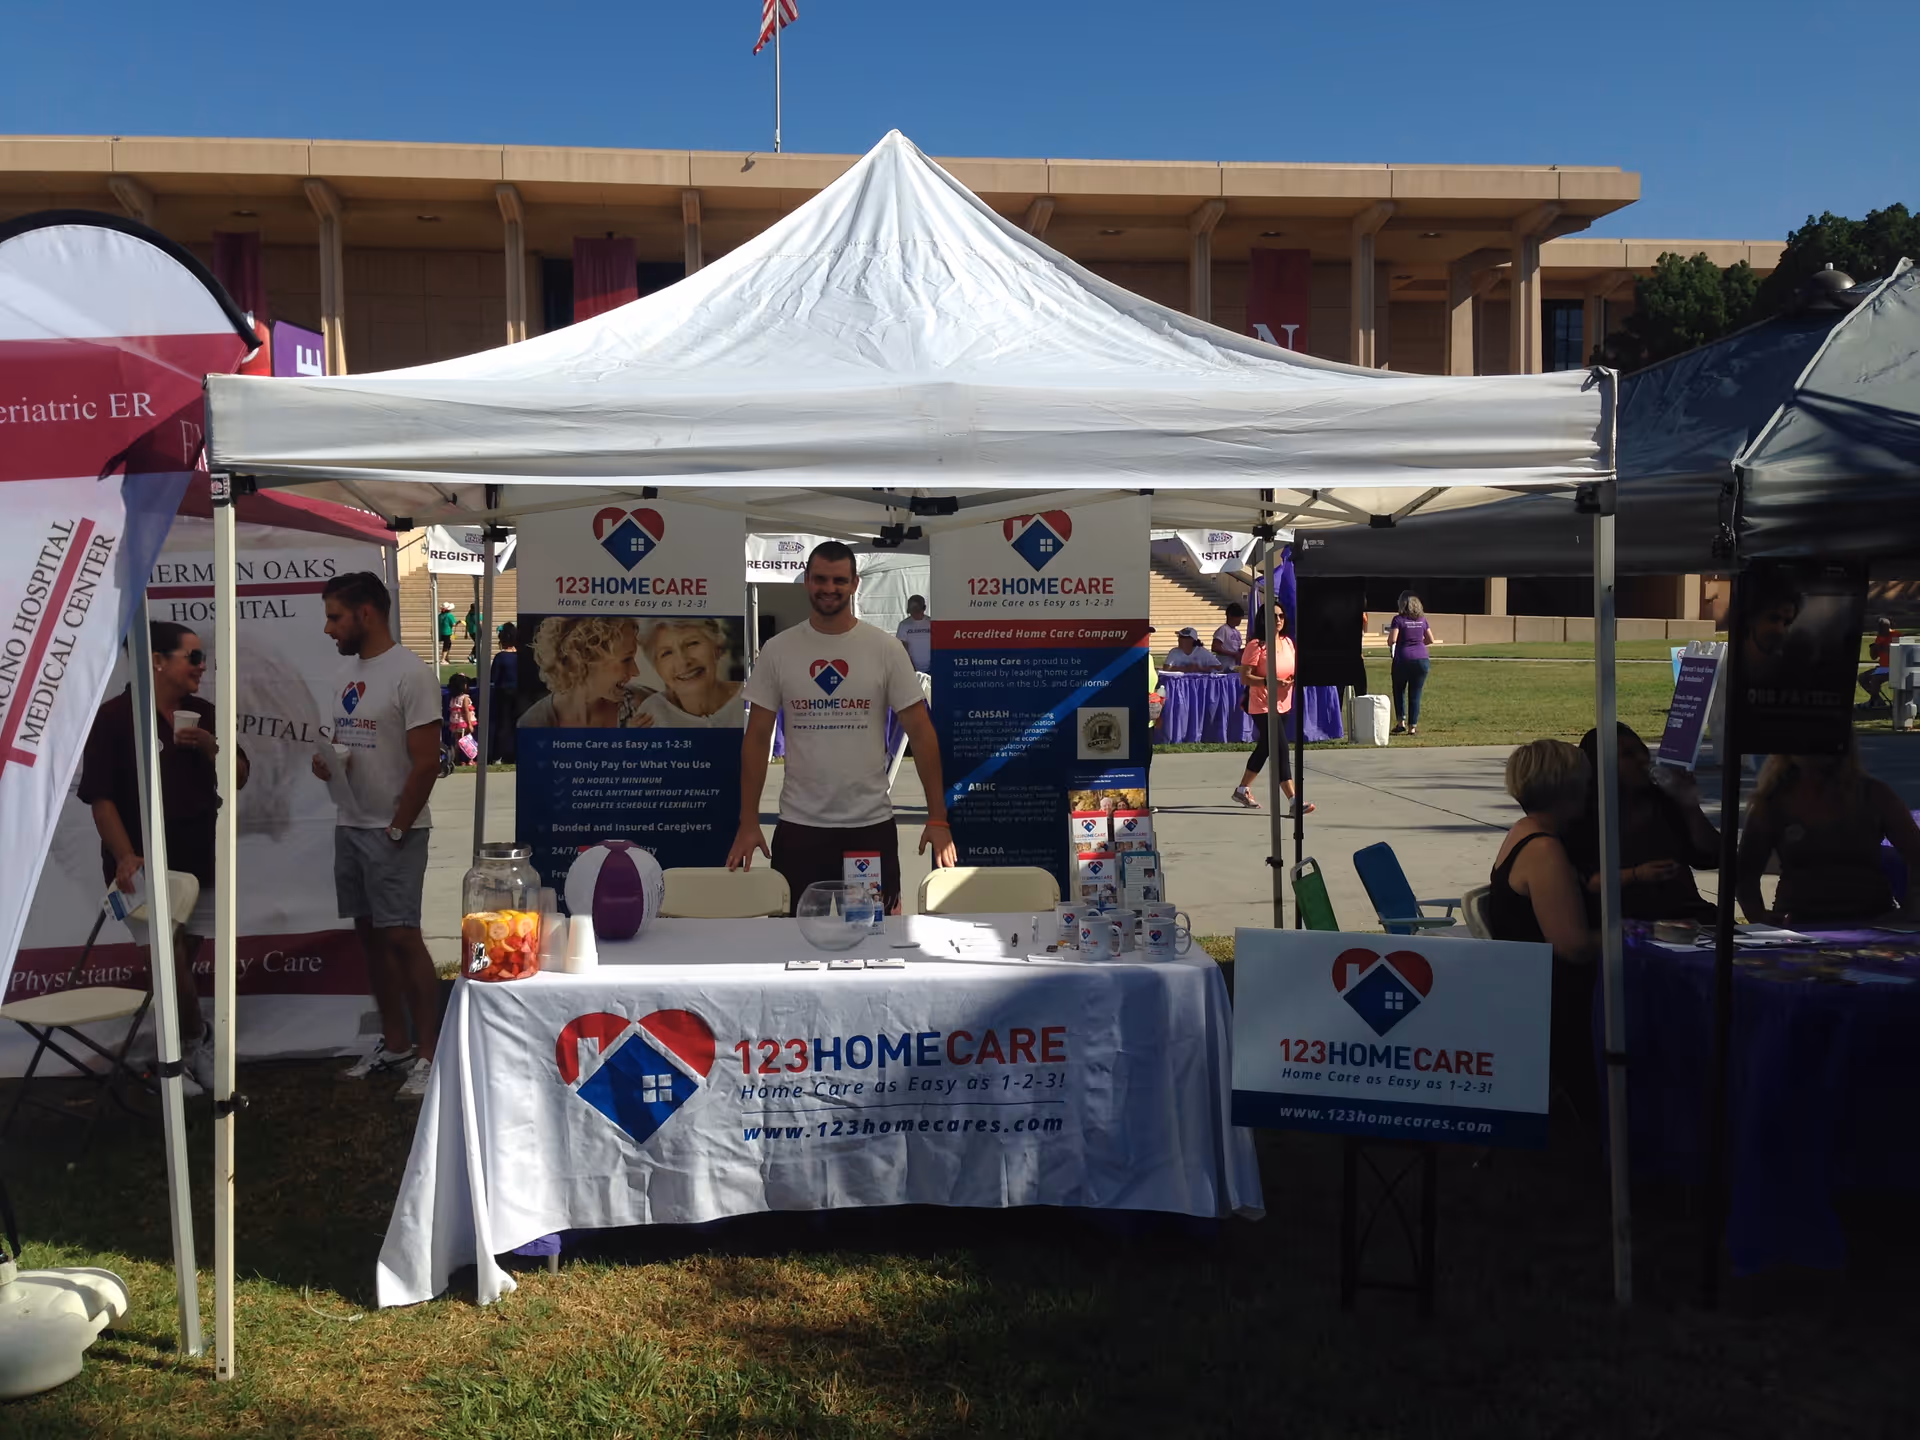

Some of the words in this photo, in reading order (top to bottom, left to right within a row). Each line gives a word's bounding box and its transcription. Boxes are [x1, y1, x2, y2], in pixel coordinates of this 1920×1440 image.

[109, 392, 156, 419] ER
[430, 550, 501, 563] REGISTRT
[12, 518, 75, 635] HOSPITAL
[150, 562, 254, 583] ERMN
[264, 558, 336, 580] OAKS
[555, 576, 708, 596] 123HOMECARE
[967, 577, 1114, 596] 123HOMECARE
[170, 599, 296, 621] HOSITAL
[558, 598, 586, 607] Home
[591, 598, 615, 607] Care
[634, 598, 657, 609] Easy
[677, 599, 707, 608] 1-2-3!
[969, 599, 998, 608] Home
[1002, 599, 1024, 607] Care
[1043, 599, 1066, 609] Easy
[1084, 598, 1114, 607] 1-2-3!
[20, 633, 77, 745] MEDICAL
[63, 533, 116, 628] CENTER
[953, 629, 1013, 639] Accredited
[1016, 629, 1047, 639] Home
[1050, 629, 1075, 638] Care
[1077, 628, 1128, 640] Company
[953, 658, 968, 666] 123
[971, 658, 998, 666] Home
[1000, 657, 1021, 666] Care
[1023, 657, 1030, 665] is
[1032, 657, 1058, 667] proud
[1071, 657, 1081, 665] be
[953, 669, 997, 677] accredited
[999, 669, 1010, 679] by
[1011, 669, 1043, 679] leading
[1017, 680, 1030, 688] the
[1032, 680, 1048, 688] U.S.
[1051, 680, 1067, 688] and
[791, 698, 871, 710] 123HOMECARE
[968, 710, 1010, 719] CAHSAH
[552, 740, 582, 749] Home
[585, 740, 609, 749] Care
[611, 741, 623, 749] as
[625, 740, 648, 751] Easy
[651, 741, 663, 749] as
[665, 740, 692, 749] 1-2-3!
[552, 760, 572, 769] You
[574, 760, 598, 771] Only
[601, 760, 619, 771] Pay
[622, 760, 638, 769] for
[640, 760, 668, 769] What
[670, 760, 689, 769] You
[692, 760, 711, 769] Use
[571, 789, 603, 797] CANCEL
[605, 789, 642, 797] ANYTIME
[645, 789, 682, 797] WITHOUT
[684, 789, 720, 797] PENALTY
[616, 801, 657, 809] SCHEDULE
[659, 801, 707, 809] FLEXIBILITY
[552, 823, 591, 833] Bonded
[593, 823, 612, 832] and
[616, 823, 655, 832] Insured
[657, 822, 712, 834] Caregivers
[263, 950, 323, 973] Care
[734, 1026, 1066, 1074] 123HOMECARE
[1280, 1038, 1495, 1077] 123HOMECARE
[741, 1081, 803, 1100] Home
[814, 1081, 864, 1097] Care
[874, 1079, 897, 1094] as
[908, 1076, 957, 1095] Easy
[967, 1075, 990, 1091] as
[1002, 1072, 1065, 1091] 1-2-3!
[1282, 1067, 1322, 1081] Home
[1328, 1070, 1361, 1084] Care
[1366, 1075, 1382, 1085] as
[1388, 1075, 1421, 1091] Easy
[1427, 1079, 1442, 1090] as
[1449, 1079, 1493, 1094] 1-2-3!
[1280, 1105, 1493, 1134] www.123homecares.com
[743, 1117, 1063, 1141] www.123homecares.com
